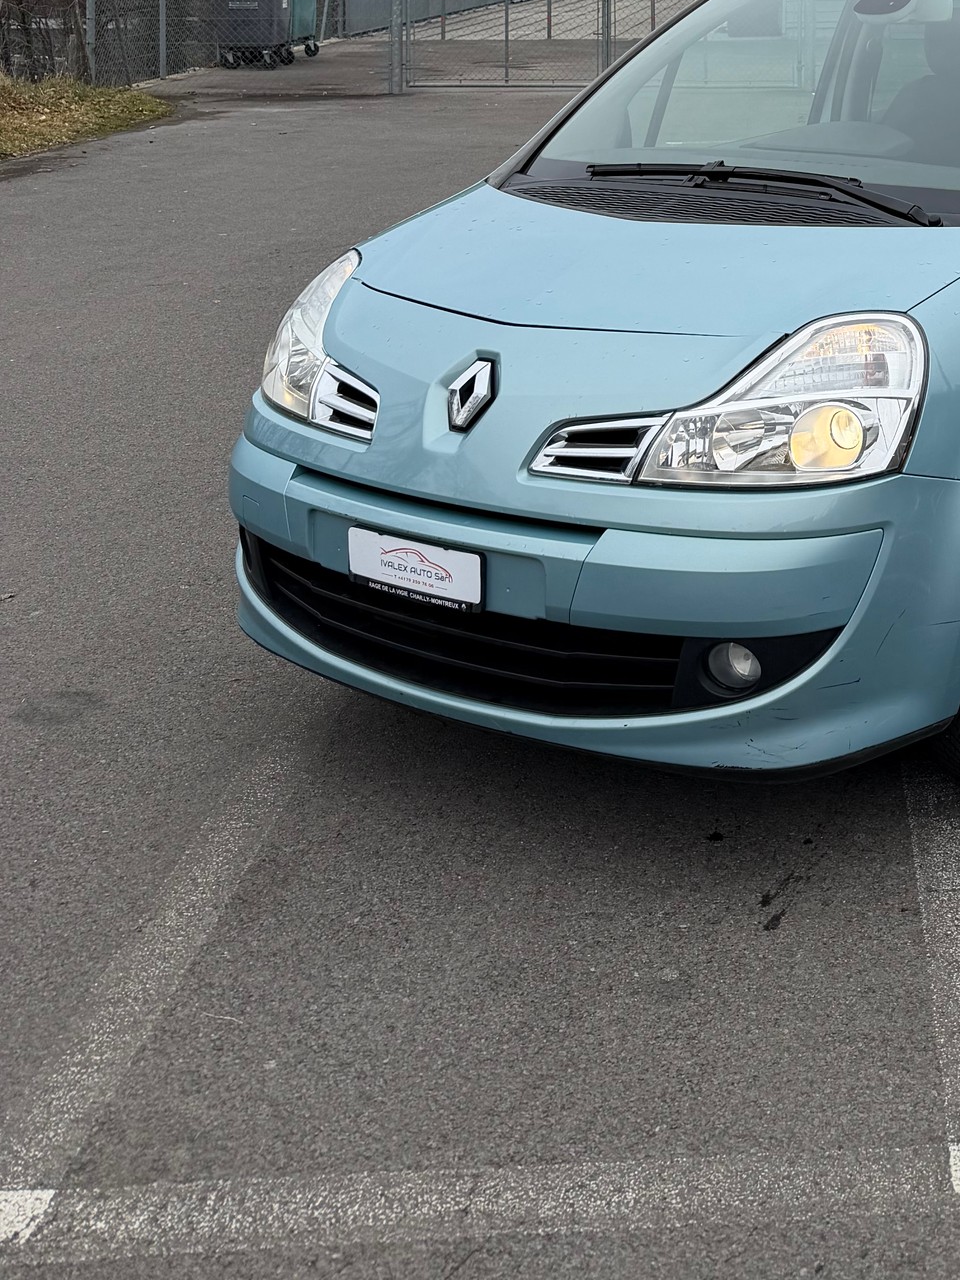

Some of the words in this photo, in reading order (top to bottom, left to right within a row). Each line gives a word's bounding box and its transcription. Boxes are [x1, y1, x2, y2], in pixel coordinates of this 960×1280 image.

[380, 559, 408, 573] IVALEX
[410, 567, 432, 579] AUTO
[381, 584, 389, 592] DE
[389, 586, 396, 594] LA
[409, 592, 459, 609] CHAILLY-MONTREUX
